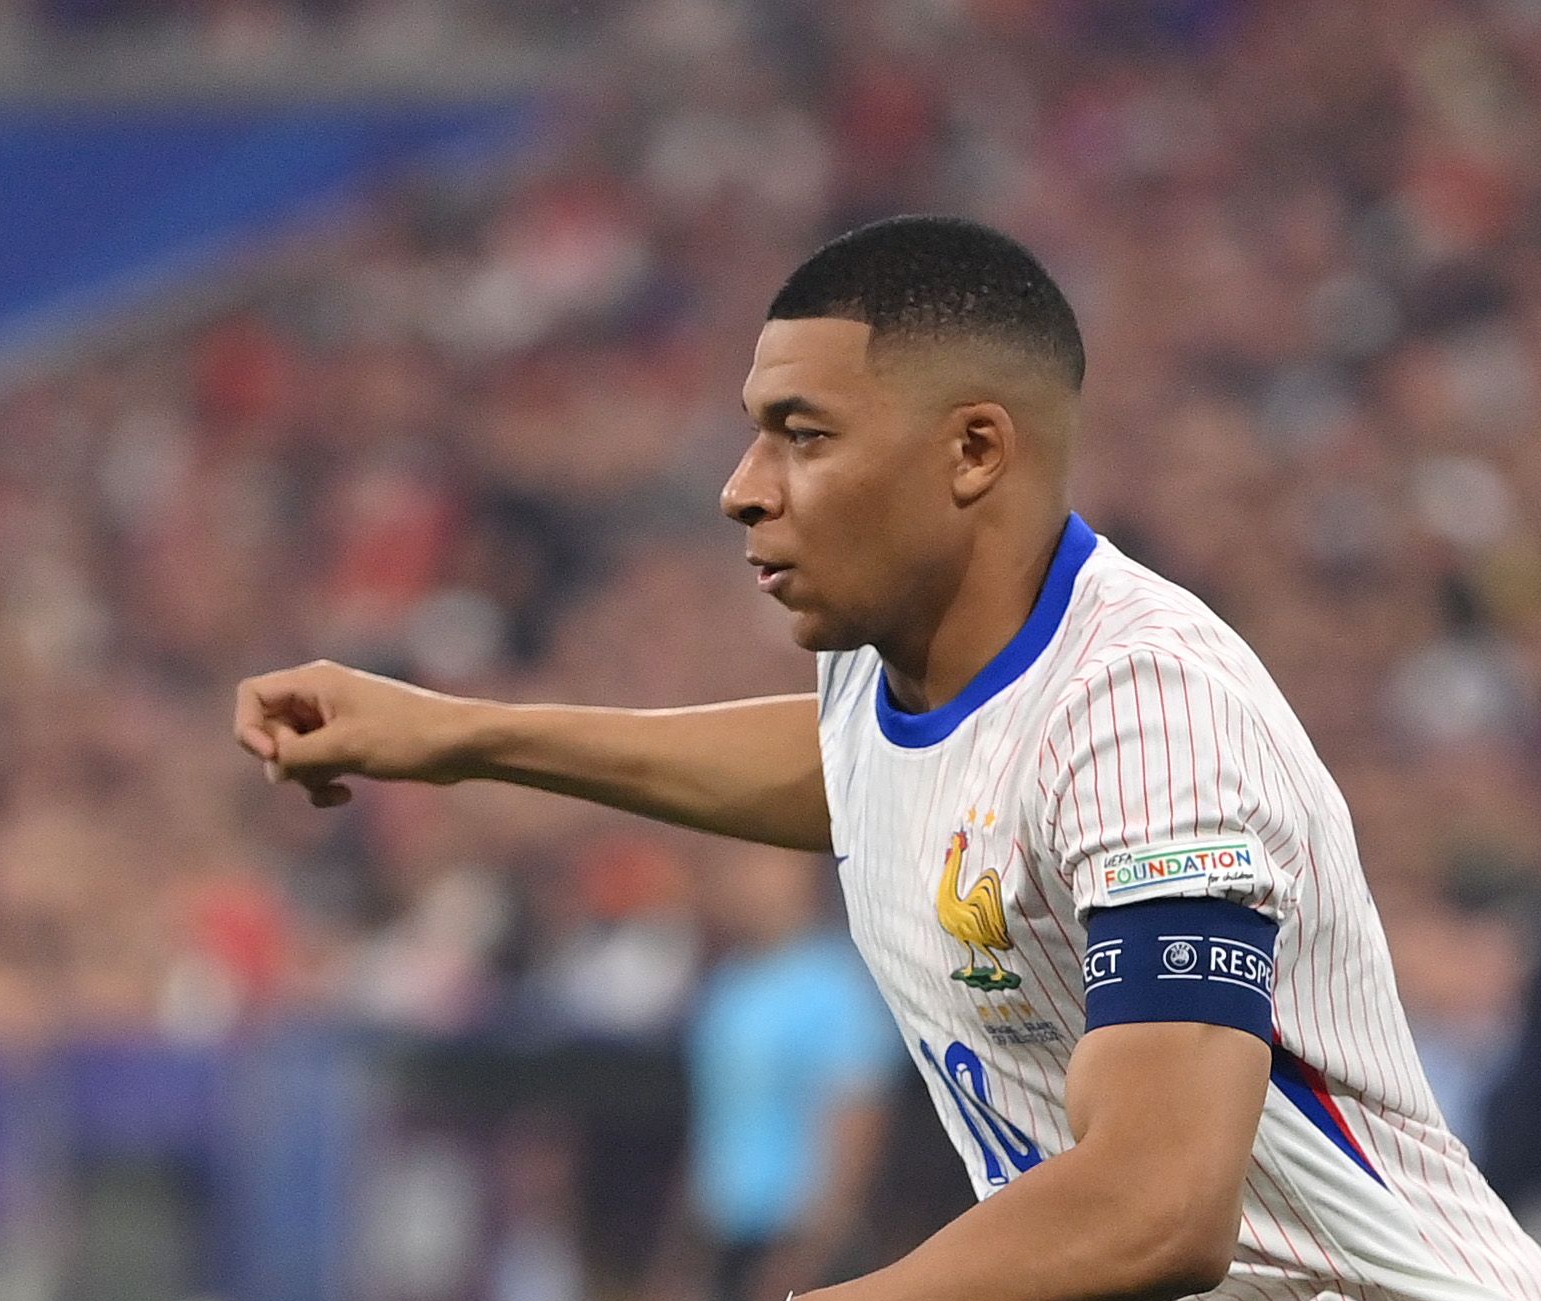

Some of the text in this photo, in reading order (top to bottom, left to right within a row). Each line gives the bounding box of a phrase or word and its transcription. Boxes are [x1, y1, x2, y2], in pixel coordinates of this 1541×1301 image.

[1104, 852, 1133, 868] UEFA
[1104, 850, 1251, 888] FOUNDATION
[1207, 871, 1254, 887] for children
[919, 1039, 1046, 1186] 10
